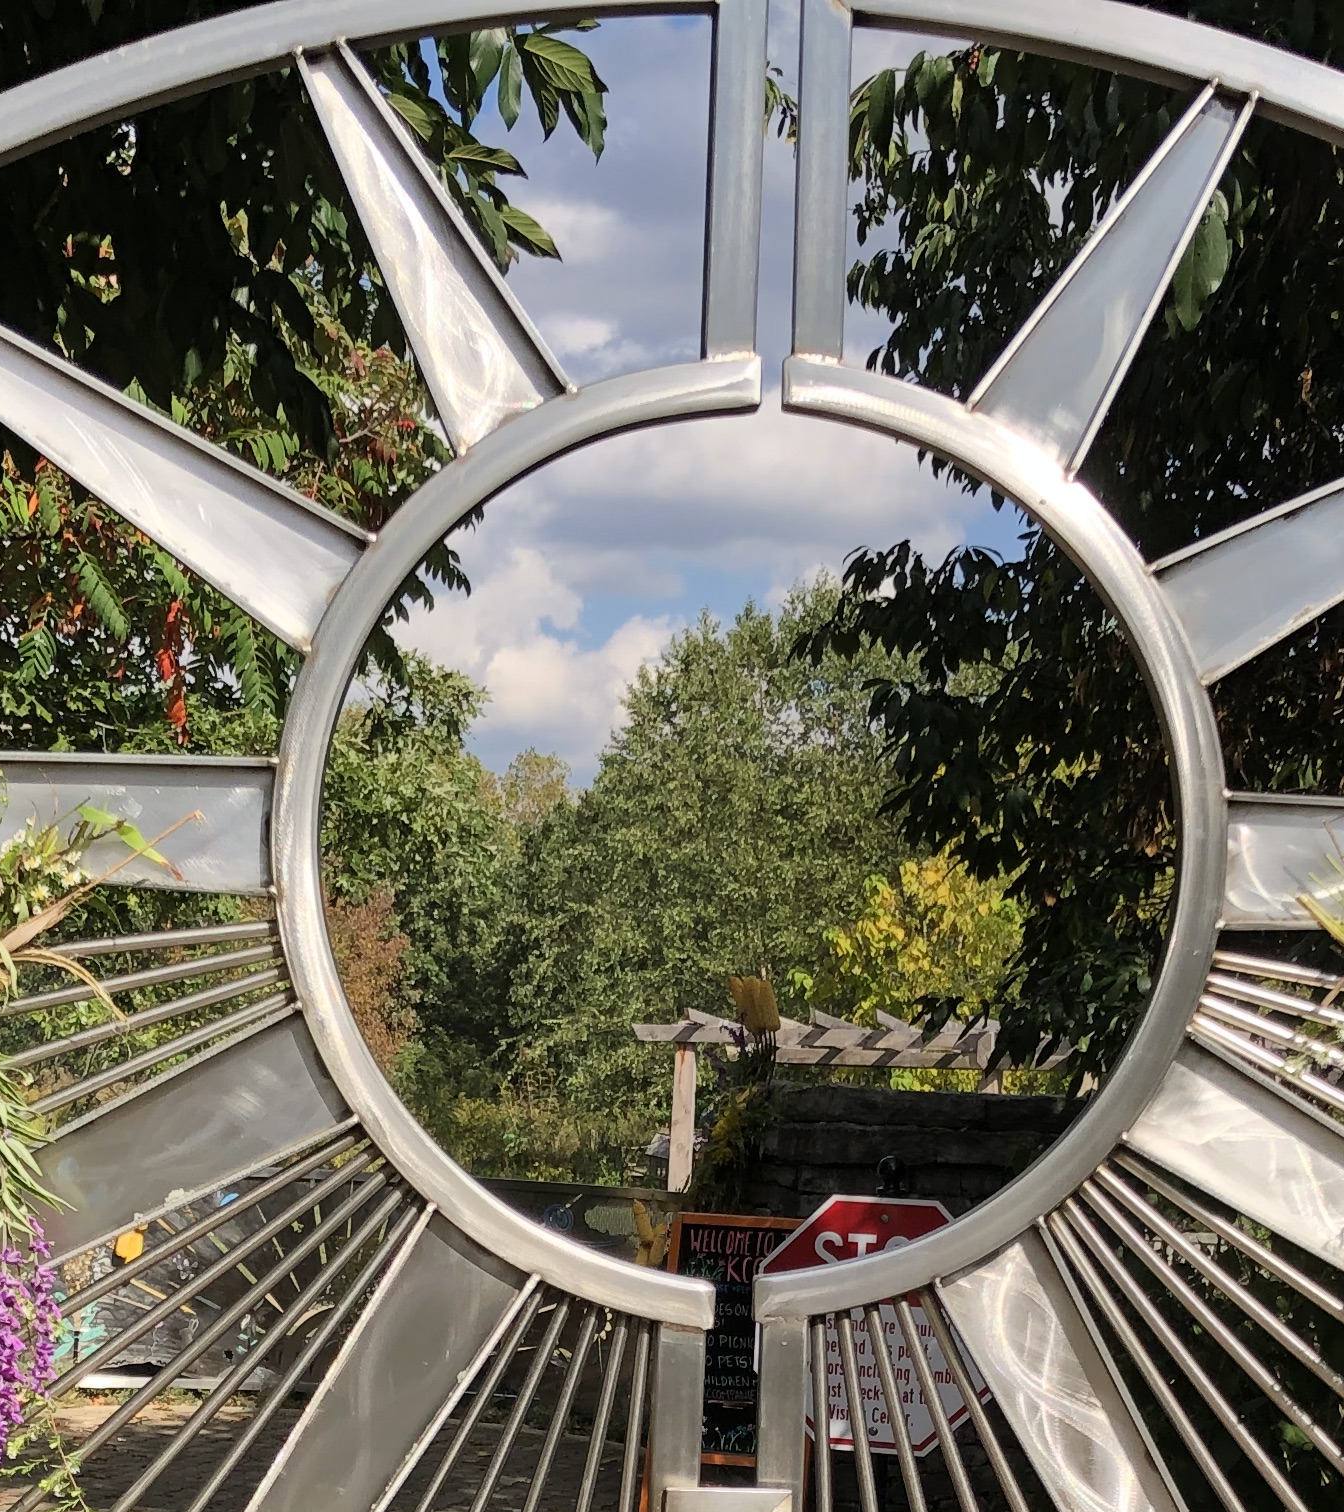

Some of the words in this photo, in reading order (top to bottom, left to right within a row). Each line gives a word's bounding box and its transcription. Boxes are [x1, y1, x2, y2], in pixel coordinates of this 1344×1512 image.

[689, 1228, 754, 1256] WELCOME
[754, 1231, 776, 1257] TO
[902, 1388, 915, 1404] at
